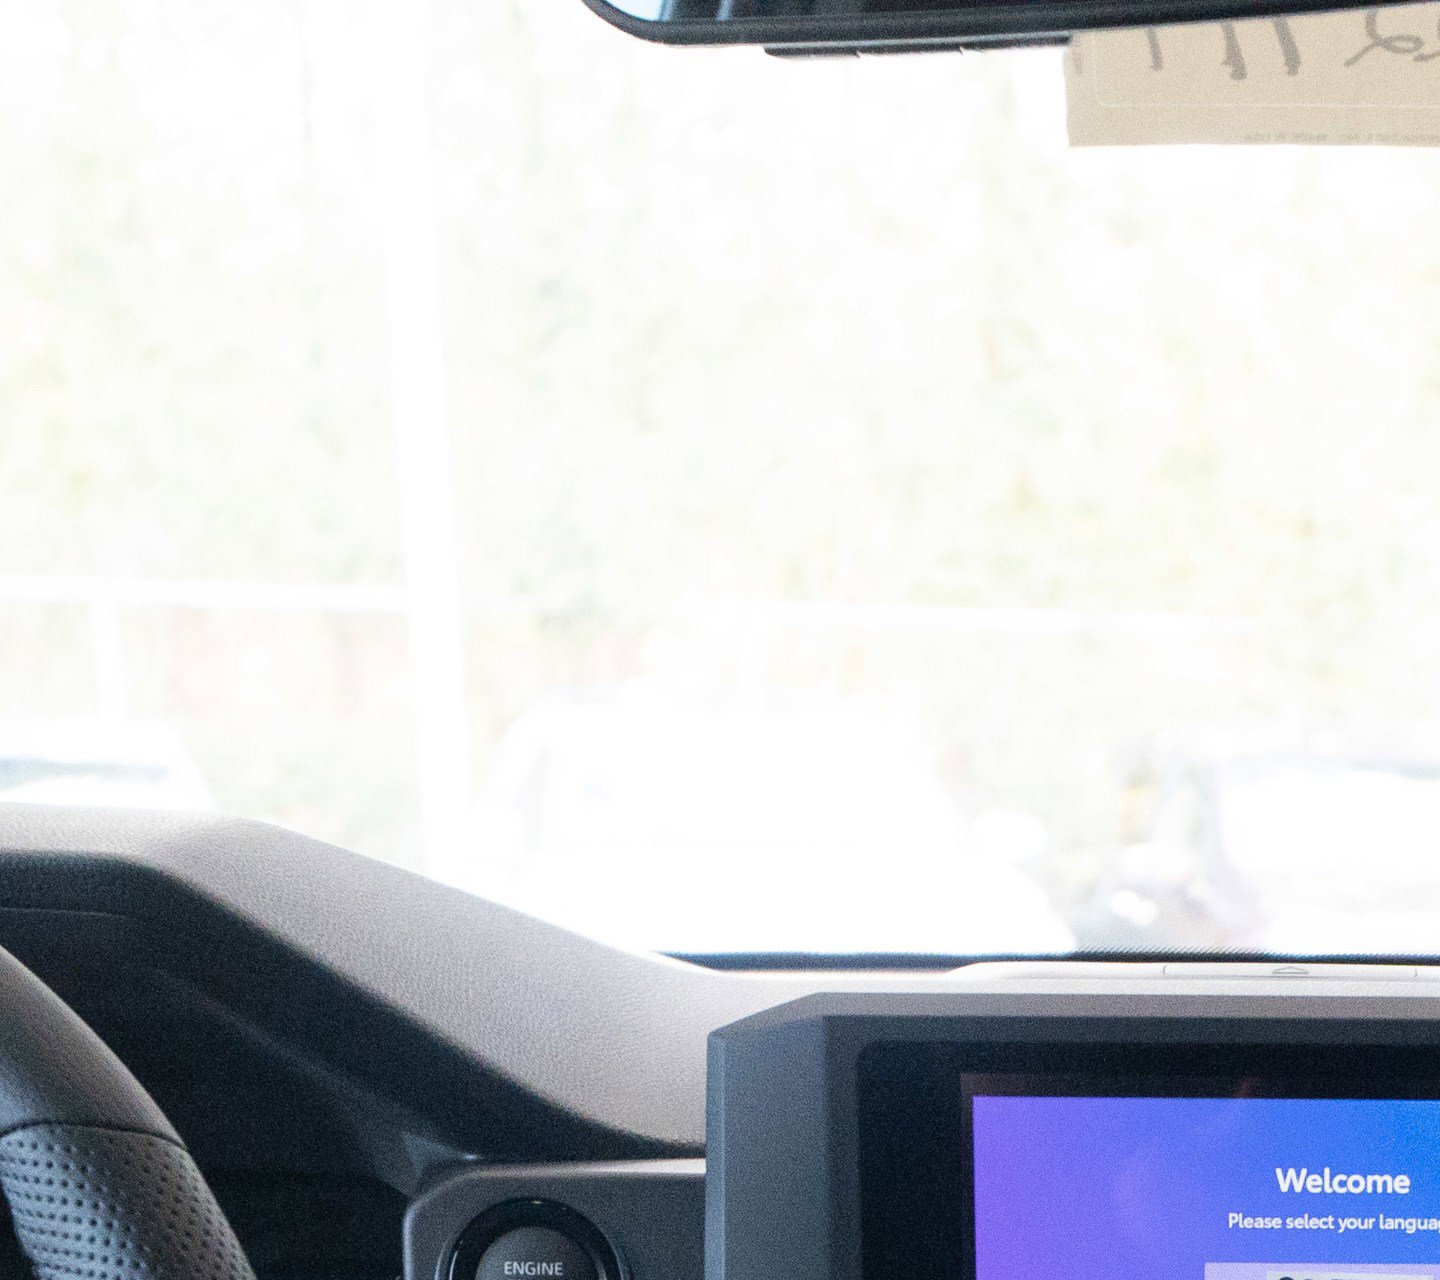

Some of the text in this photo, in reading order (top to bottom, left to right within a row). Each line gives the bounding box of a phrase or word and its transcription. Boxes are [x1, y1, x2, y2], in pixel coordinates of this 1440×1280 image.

[1275, 1166, 1411, 1194] Welcome
[1228, 1212, 1282, 1229] Please
[1286, 1213, 1334, 1230] select
[1337, 1216, 1375, 1233] your
[504, 1261, 563, 1276] ENGINE
